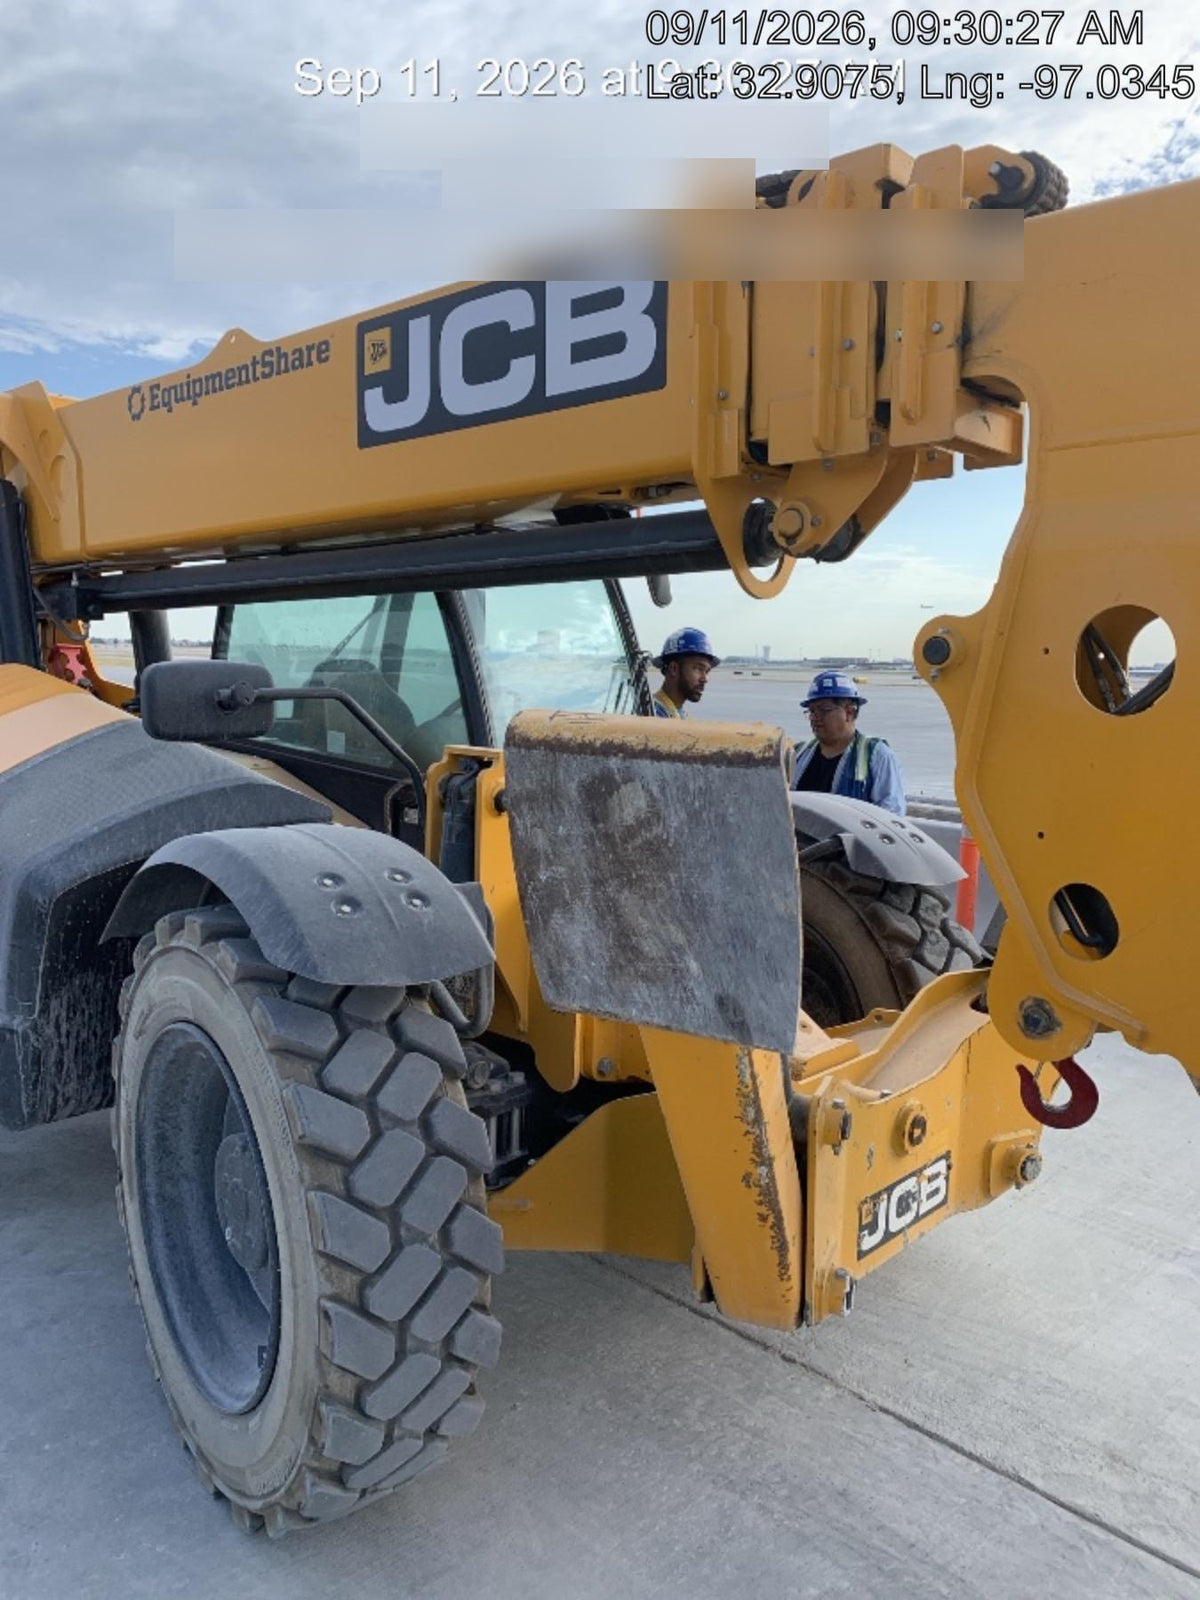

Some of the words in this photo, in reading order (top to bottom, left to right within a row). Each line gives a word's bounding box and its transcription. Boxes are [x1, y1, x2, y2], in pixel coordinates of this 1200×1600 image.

[149, 339, 330, 413] EquipmentShare
[364, 281, 657, 432] JCB
[860, 1158, 947, 1251] JCB
